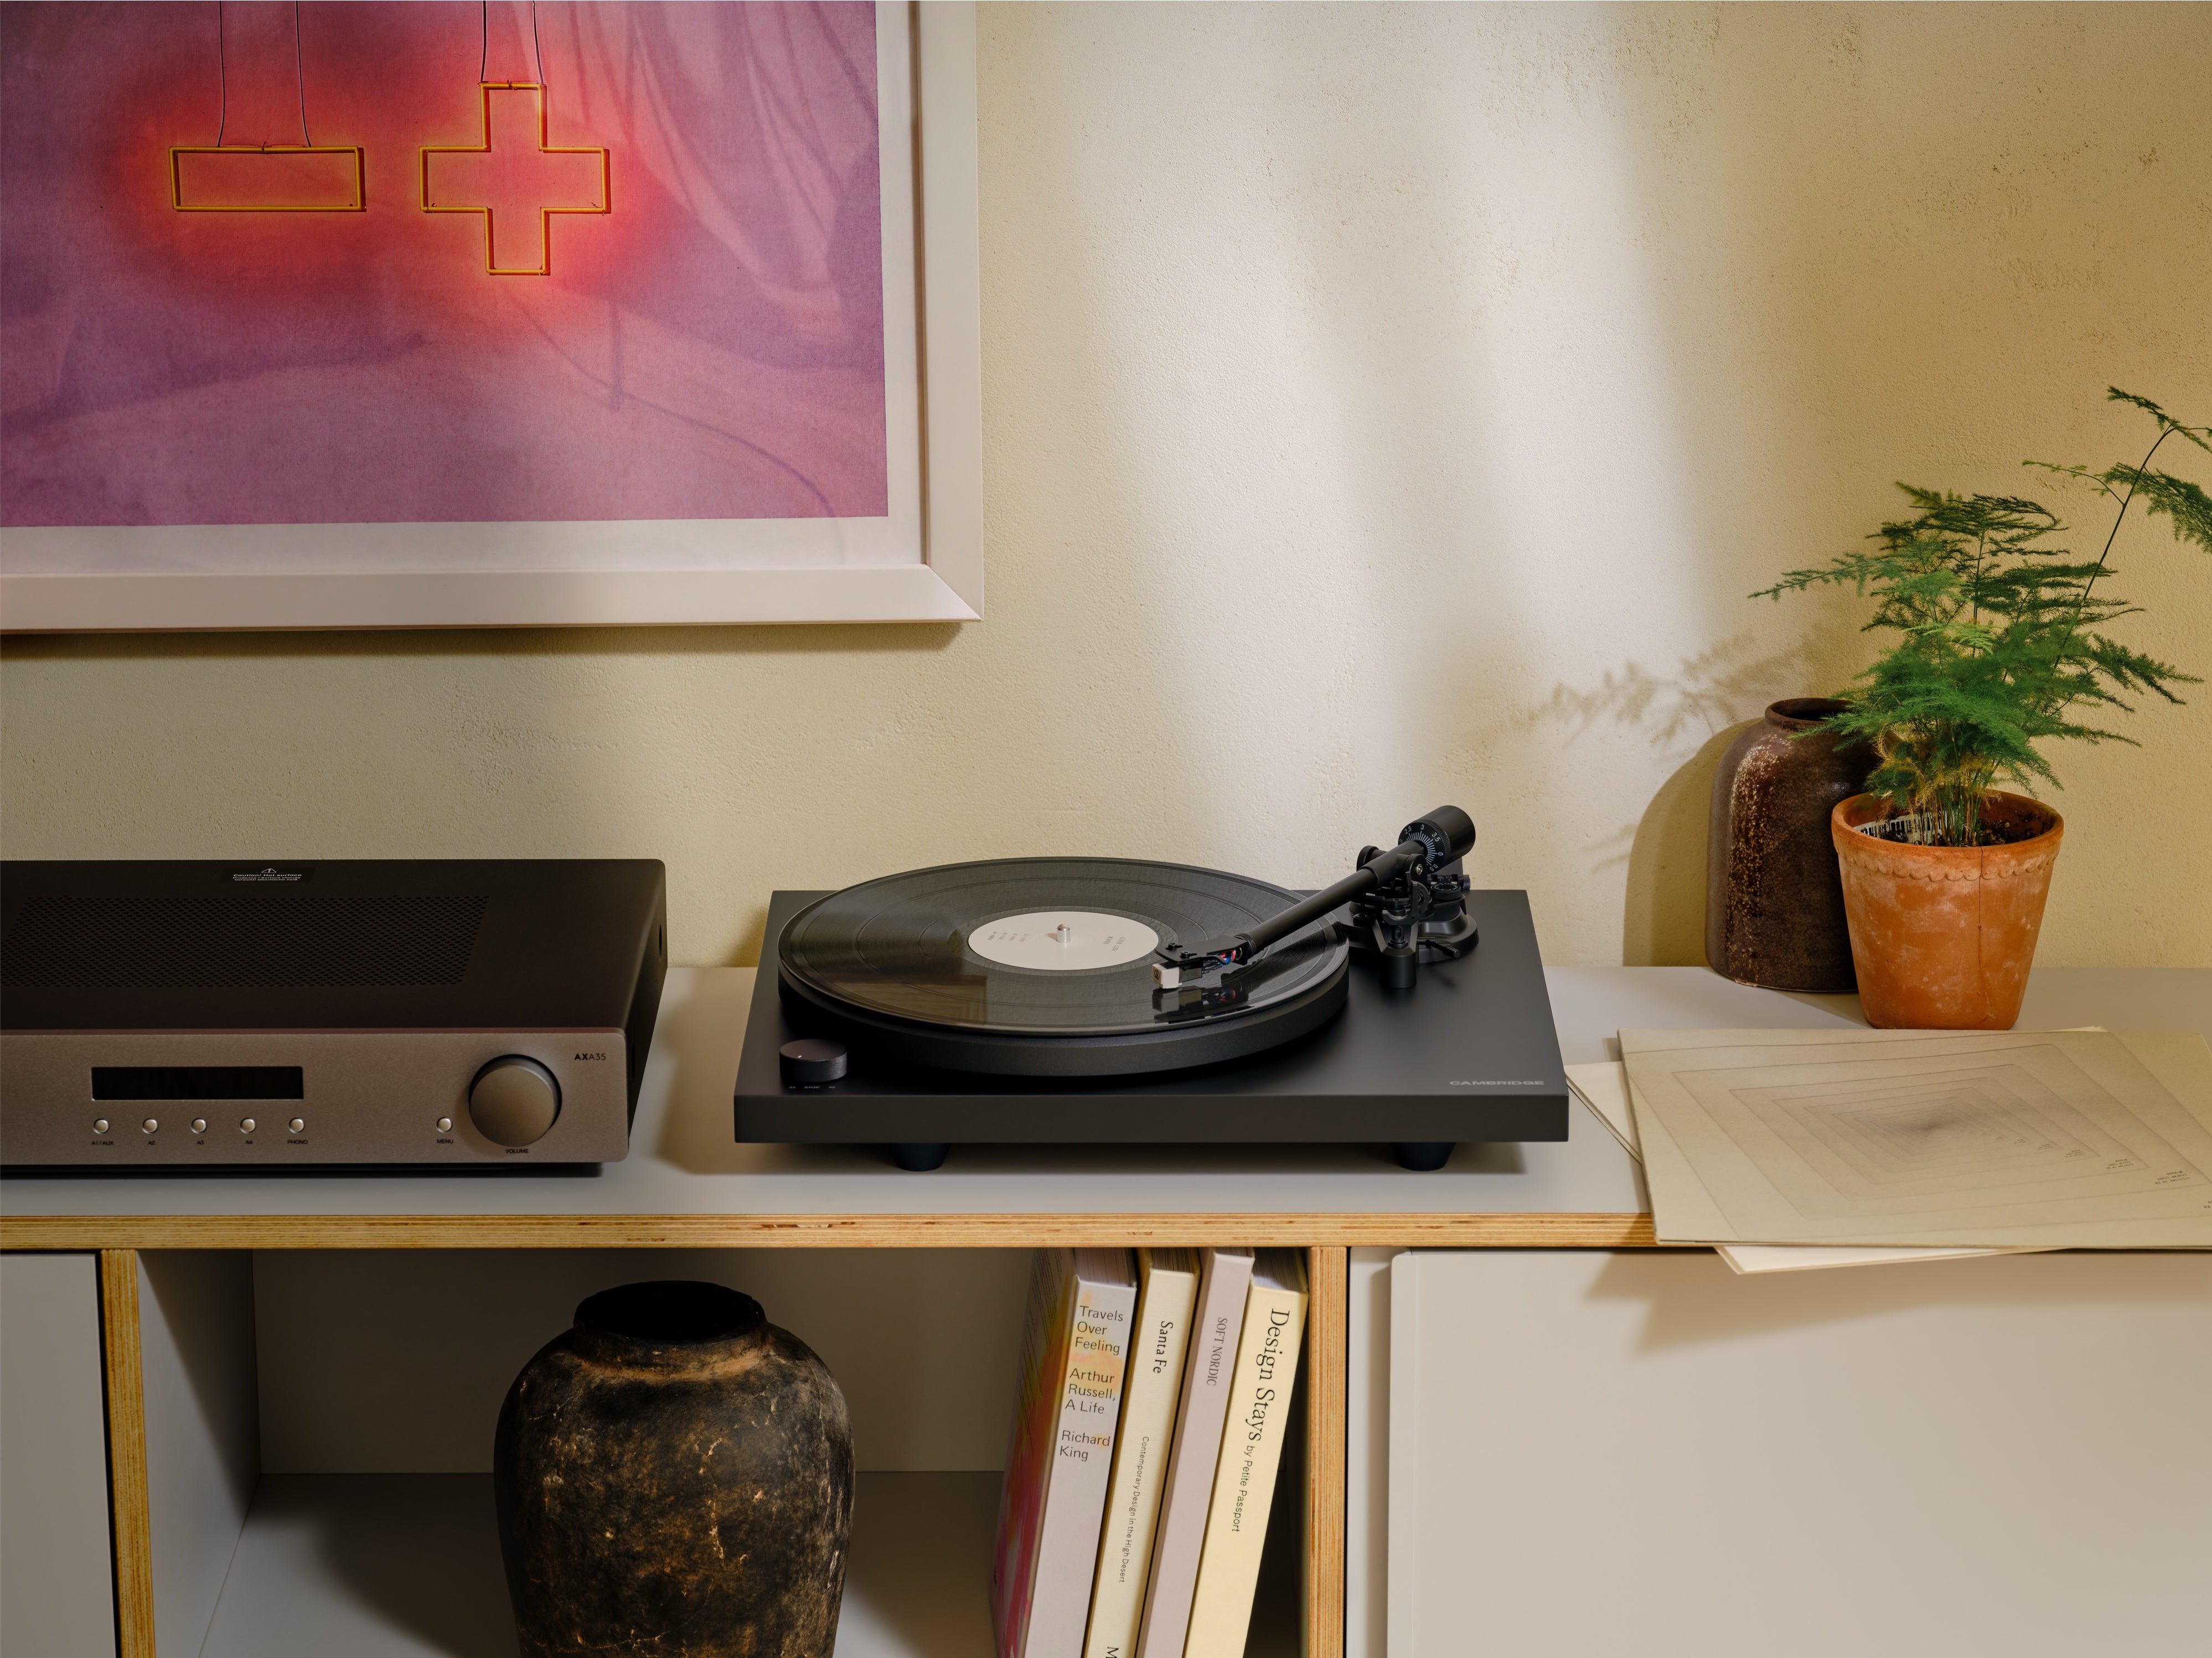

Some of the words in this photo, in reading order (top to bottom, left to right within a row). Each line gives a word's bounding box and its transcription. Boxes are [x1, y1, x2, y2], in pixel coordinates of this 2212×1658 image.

[1404, 826, 1412, 835] 2.5
[1431, 832, 1441, 842] 3.5
[1079, 1305, 1123, 1322] Travels
[1077, 1321, 1107, 1335] Over
[1214, 1317, 1228, 1344] SOFT
[1075, 1336, 1120, 1356] Feeling
[1156, 1320, 1174, 1355] Santa
[1256, 1308, 1290, 1381] Design
[1153, 1359, 1167, 1374] Fe
[1206, 1346, 1223, 1386] NORDIC
[1069, 1368, 1115, 1384] Arthur
[1068, 1384, 1115, 1401] Russell,
[1065, 1399, 1076, 1411] A
[1080, 1401, 1104, 1414] Life
[1245, 1388, 1275, 1441] Stays
[1061, 1430, 1110, 1446] Richard
[1060, 1445, 1088, 1462] King
[1244, 1445, 1255, 1457] by
[1133, 1436, 1149, 1490] Contemporary
[1240, 1460, 1253, 1486] Petite
[1129, 1491, 1140, 1516] Design
[1232, 1489, 1247, 1532] Passport
[1122, 1540, 1132, 1557] High
[1119, 1559, 1129, 1583] Desert
